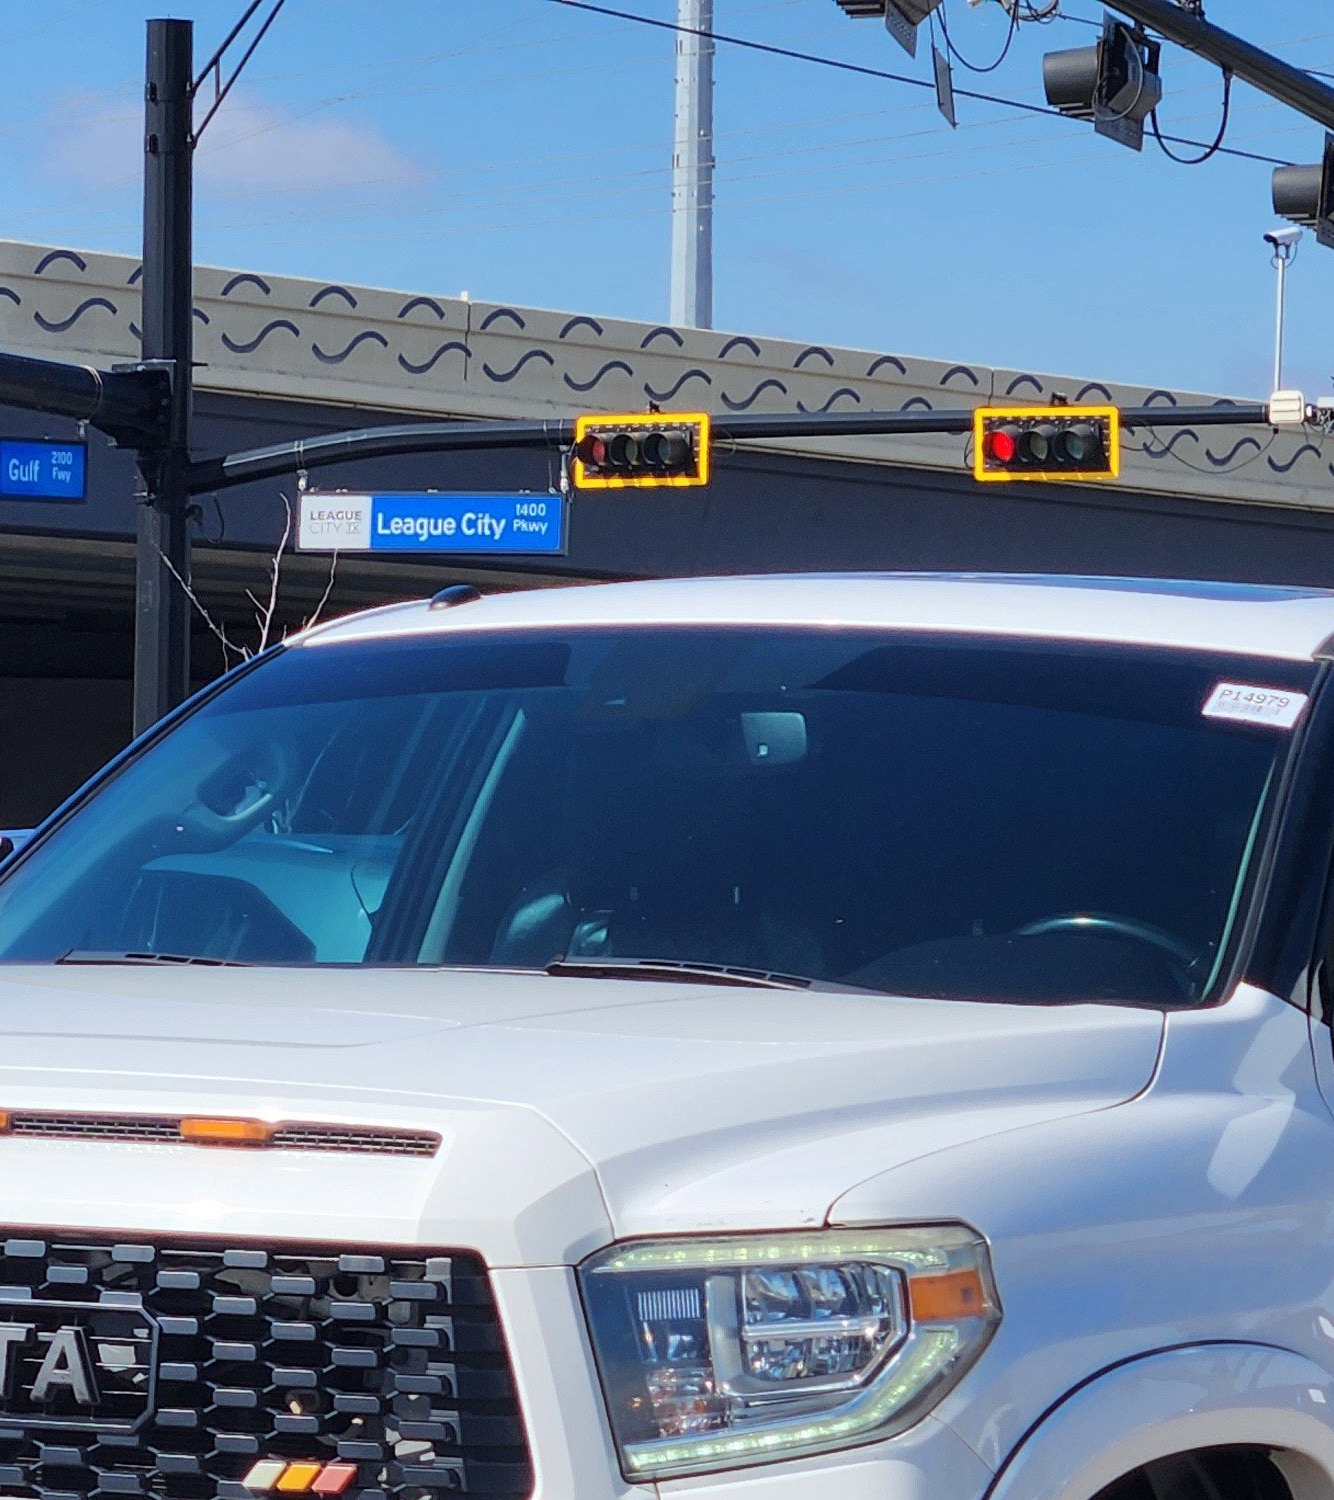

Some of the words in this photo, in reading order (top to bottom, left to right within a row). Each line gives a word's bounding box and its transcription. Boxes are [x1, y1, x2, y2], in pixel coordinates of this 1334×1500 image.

[8, 458, 41, 482] Gulf
[51, 467, 72, 483] Fwy
[310, 510, 363, 522] LEAGUE
[515, 503, 547, 517] 1400
[309, 522, 343, 534] CITY
[376, 512, 457, 542] League
[460, 512, 507, 541] City
[513, 519, 549, 536] Pkwy
[1219, 689, 1291, 708] P14979
